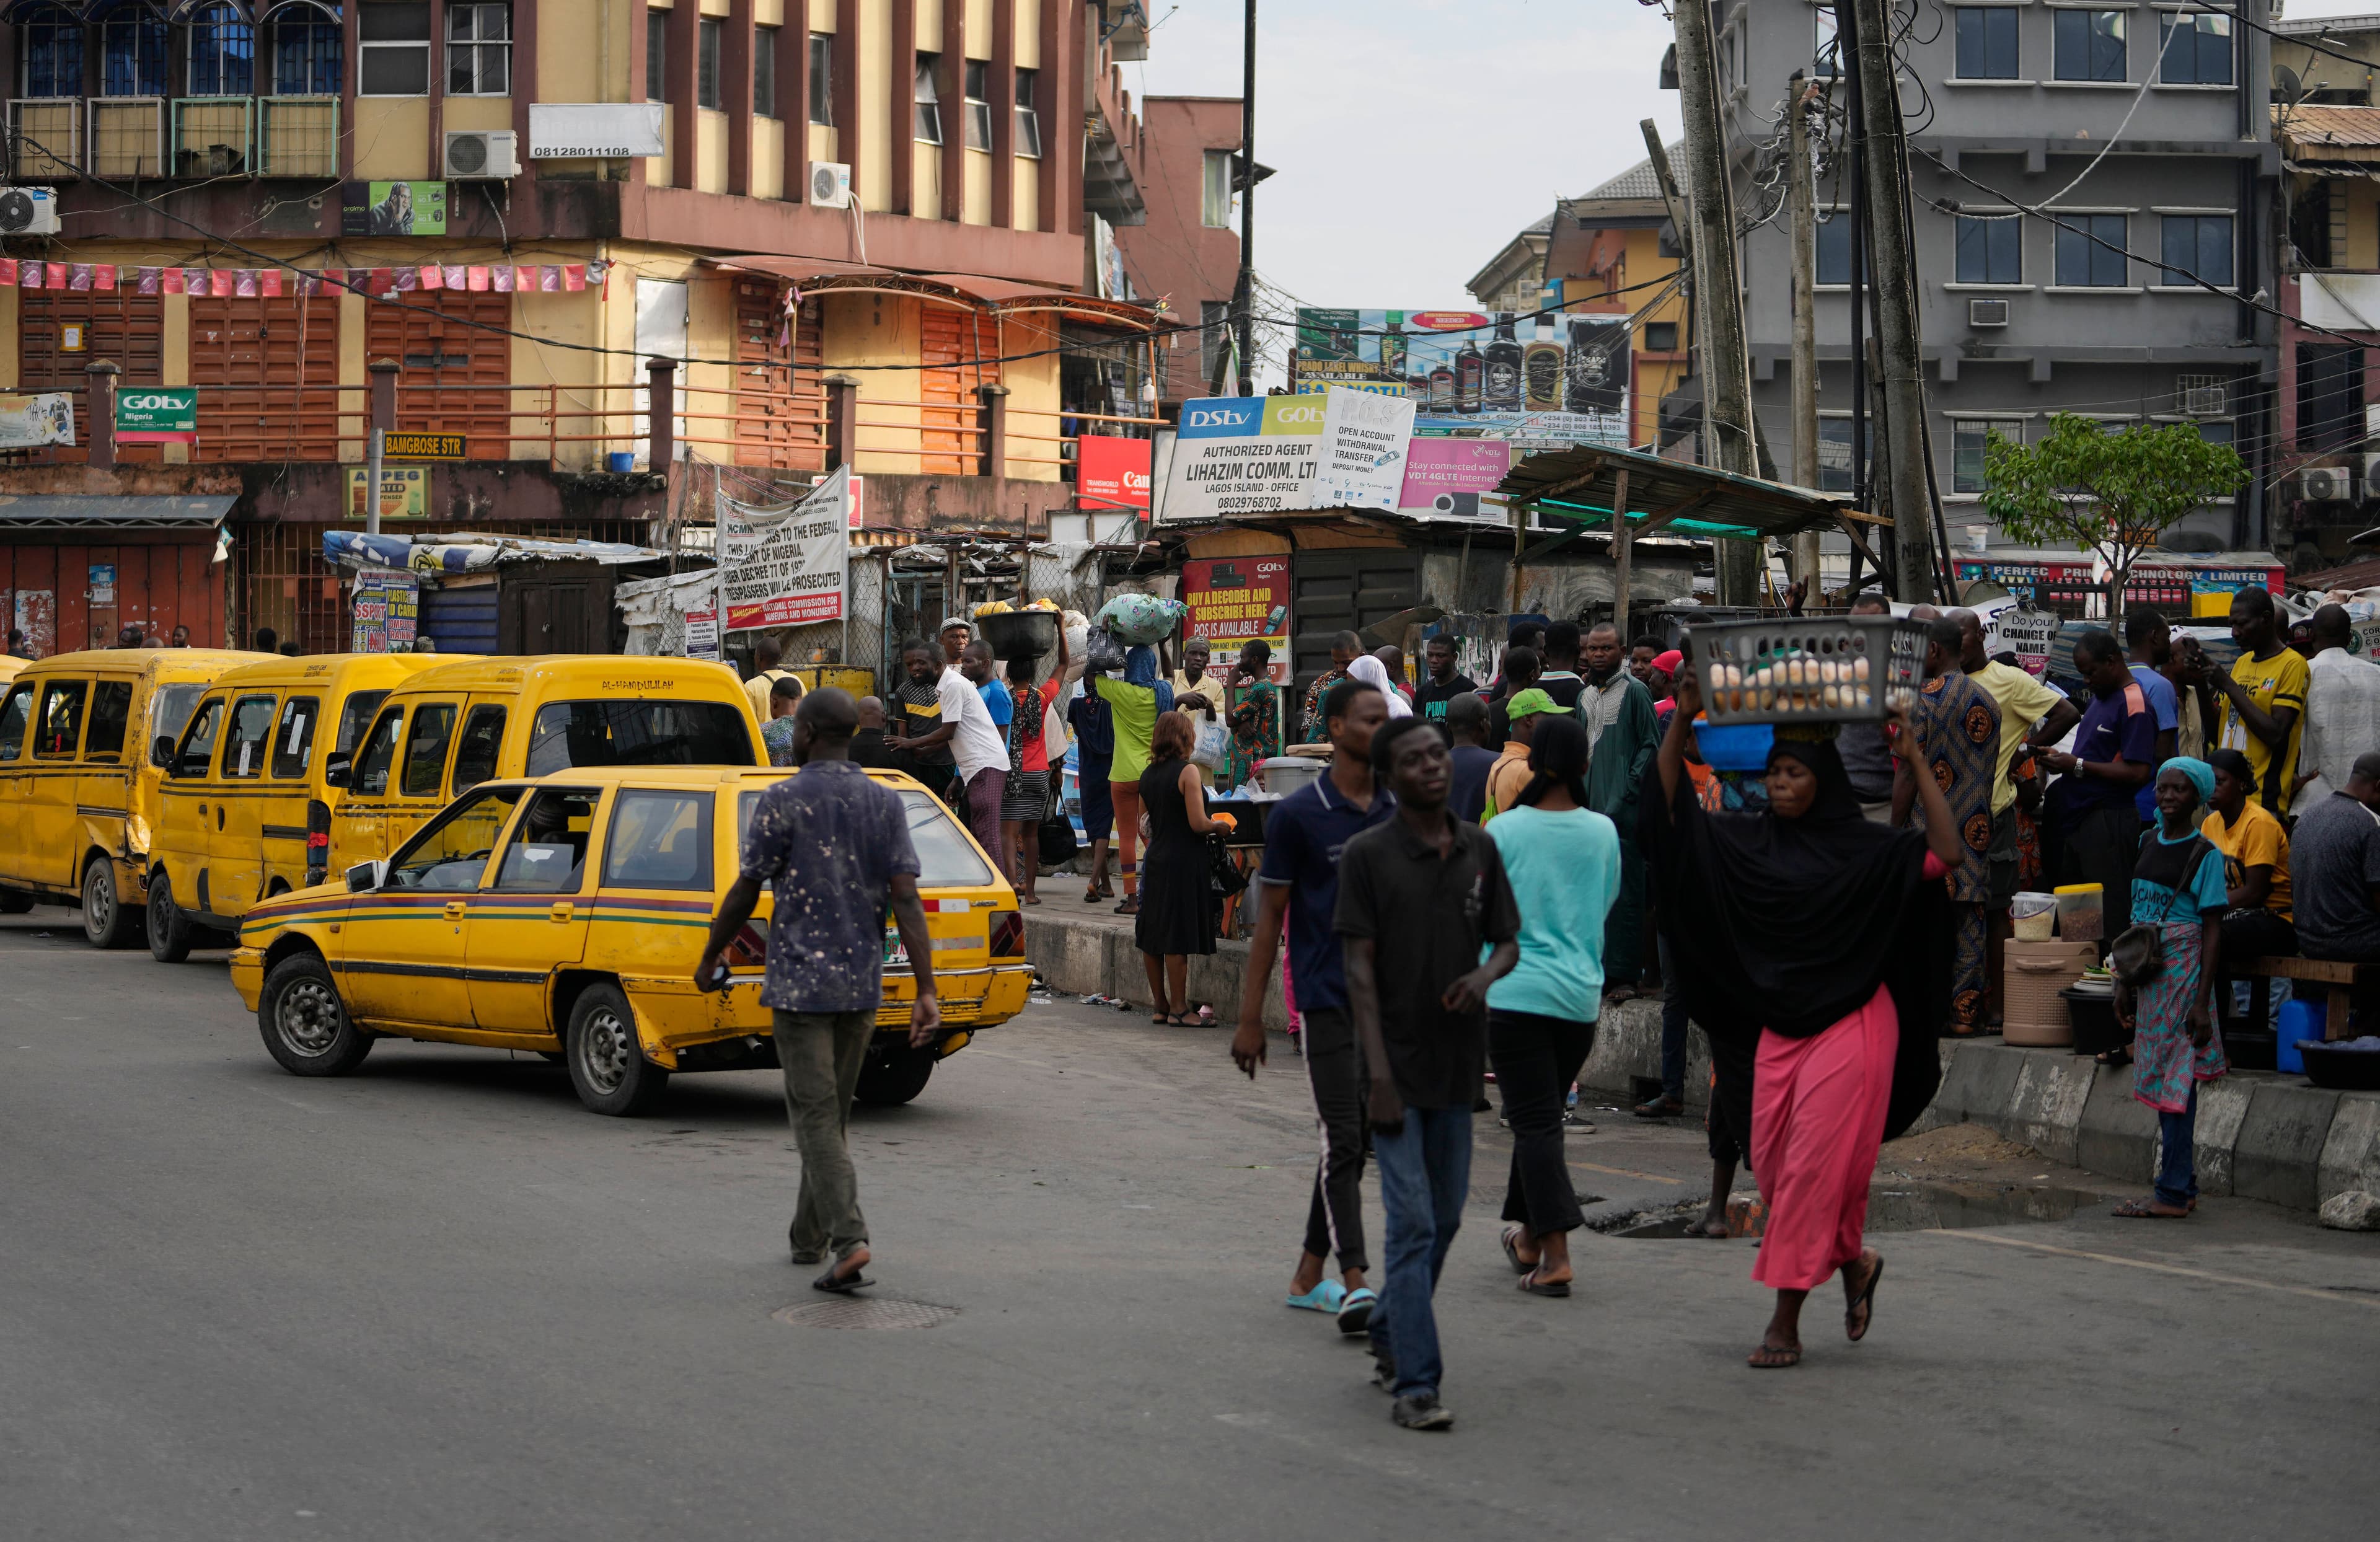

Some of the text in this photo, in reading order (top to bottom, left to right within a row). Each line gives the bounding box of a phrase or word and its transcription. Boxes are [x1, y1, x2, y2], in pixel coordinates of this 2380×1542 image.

[534, 148, 629, 156] 08128011108
[1298, 361, 1323, 372] PRADO
[1303, 372, 1367, 380] AVAILABLE
[123, 395, 192, 409] GOtv
[125, 413, 153, 421] Nigeria
[1189, 410, 1251, 427] DStv
[1338, 426, 1396, 442] OPEN ACCOUNT
[386, 436, 461, 454] BAMGBOSE STR
[1203, 444, 1313, 458] AUTHORIZED AGENT
[1337, 438, 1386, 452] WITHDRAWAL
[1335, 449, 1374, 463] TRANSFER
[1186, 462, 1243, 481] LIHAZIM
[1246, 462, 1293, 479] COMM.
[1333, 462, 1374, 474] DEPOSIT MONEY
[1409, 461, 1427, 470] Stay
[1430, 463, 1476, 471] connected
[354, 470, 420, 482] APEG
[1123, 471, 1150, 488] Can
[1429, 472, 1457, 481] 4GLTE
[1460, 474, 1496, 482] Internet
[1086, 479, 1119, 487] TRANSWORLD
[1205, 483, 1232, 493] LAGOS
[1233, 483, 1264, 493] ISLAND
[1271, 482, 1299, 492] OFFICE
[814, 495, 839, 505] Monuments
[1218, 496, 1282, 509] 08029768702
[727, 519, 839, 556] THIS TO THE FEDERAL
[761, 543, 804, 562] OF NIGERIA.
[739, 565, 769, 581] DECREE
[769, 563, 778, 578] 77
[780, 562, 788, 576] OF
[1257, 563, 1287, 572] GOtv
[1994, 566, 2048, 576] PERFEC
[2130, 570, 2203, 580] CHNOLOGY
[2210, 573, 2267, 581] LIMITED
[724, 571, 840, 601] TRESPASSERS PROSECUTED
[388, 589, 407, 602] PLASTIC
[1187, 588, 1271, 606] BUY A DECODER AND
[355, 602, 386, 619] SSPORT
[388, 604, 417, 617] ID CARD
[762, 596, 837, 613] NATIONAL COMMISSION FOR
[764, 606, 837, 622] MUSEUMS AND MONUMENTS
[1195, 604, 1267, 621] SUBSCRIBE HERE
[388, 619, 416, 630] COMPUTER
[2012, 615, 2054, 628] Do your
[1194, 620, 1259, 637] POS IS AVAILABLE
[2363, 627, 2380, 635] COR
[388, 630, 414, 641] TRAINING
[2016, 642, 2045, 654] NAME
[2021, 654, 2045, 663] Here
[1203, 666, 1277, 677] HAZIM TD
